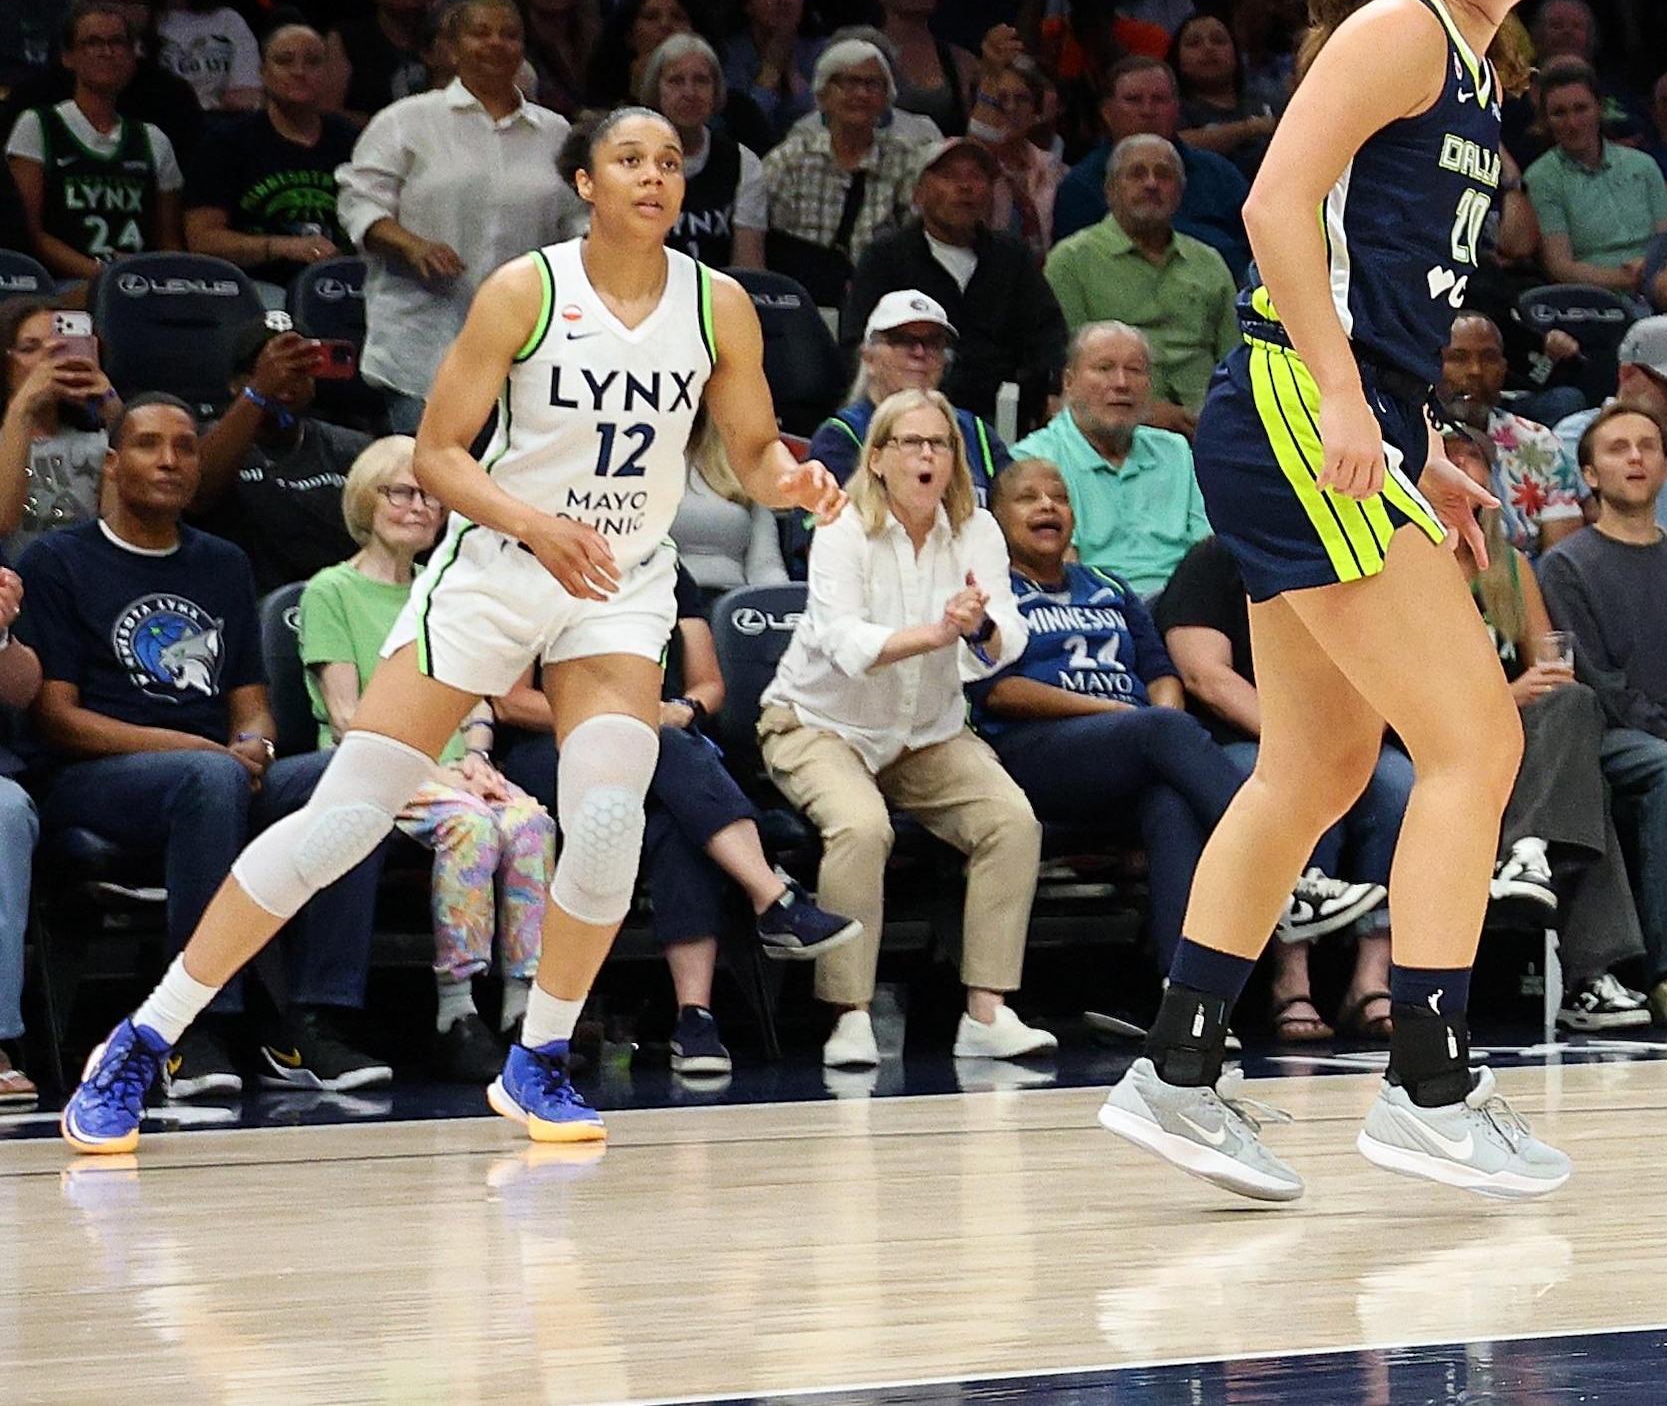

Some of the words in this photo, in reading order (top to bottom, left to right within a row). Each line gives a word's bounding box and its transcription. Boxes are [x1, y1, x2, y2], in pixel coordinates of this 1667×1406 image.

[65, 183, 144, 211] LYNX
[83, 214, 144, 256] 24
[671, 208, 732, 237] YNX
[151, 278, 240, 296] LEXUS
[549, 365, 697, 412] LYNX
[594, 423, 656, 477] 12
[566, 487, 648, 511] MAYO
[1058, 669, 1133, 694] MAYO
